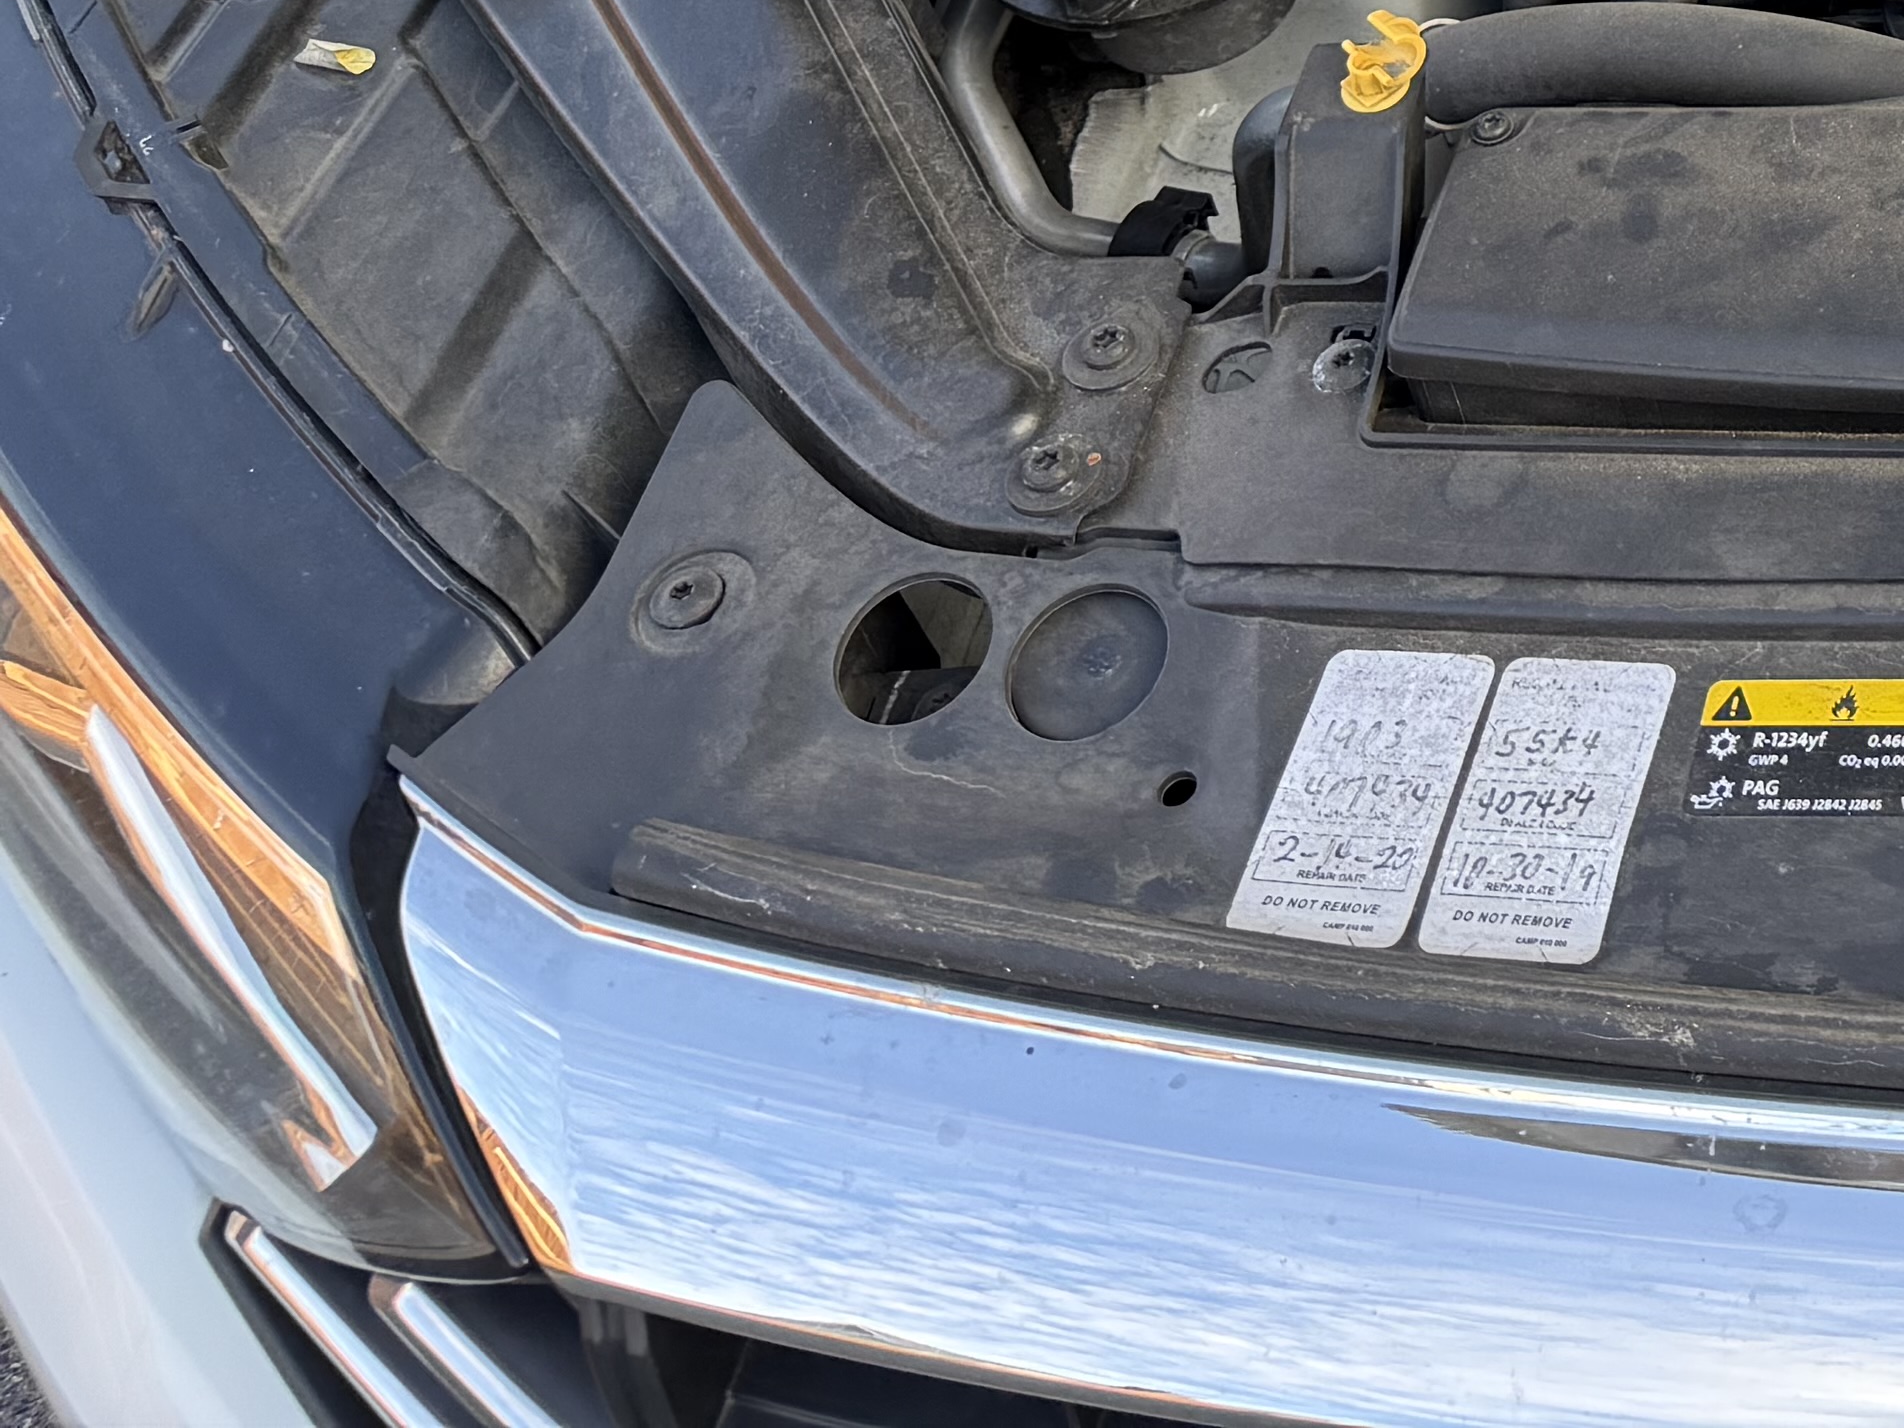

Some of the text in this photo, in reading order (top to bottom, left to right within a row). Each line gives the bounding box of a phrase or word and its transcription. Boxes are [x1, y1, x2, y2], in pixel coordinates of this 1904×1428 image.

[1752, 730, 1828, 752] R-1234yf
[1748, 754, 1778, 766] GWP
[1780, 754, 1788, 765] 4
[1864, 756, 1879, 768] eq
[1741, 780, 1780, 795] PAG
[1477, 781, 1596, 819] 407434
[1757, 798, 1781, 811] SAE
[1782, 798, 1810, 811] J639
[1812, 798, 1847, 811] J2842
[1848, 798, 1882, 811] J2845
[1262, 894, 1382, 915] DO NOT REMOVE
[1453, 910, 1573, 930] DO NOT REMOVE
